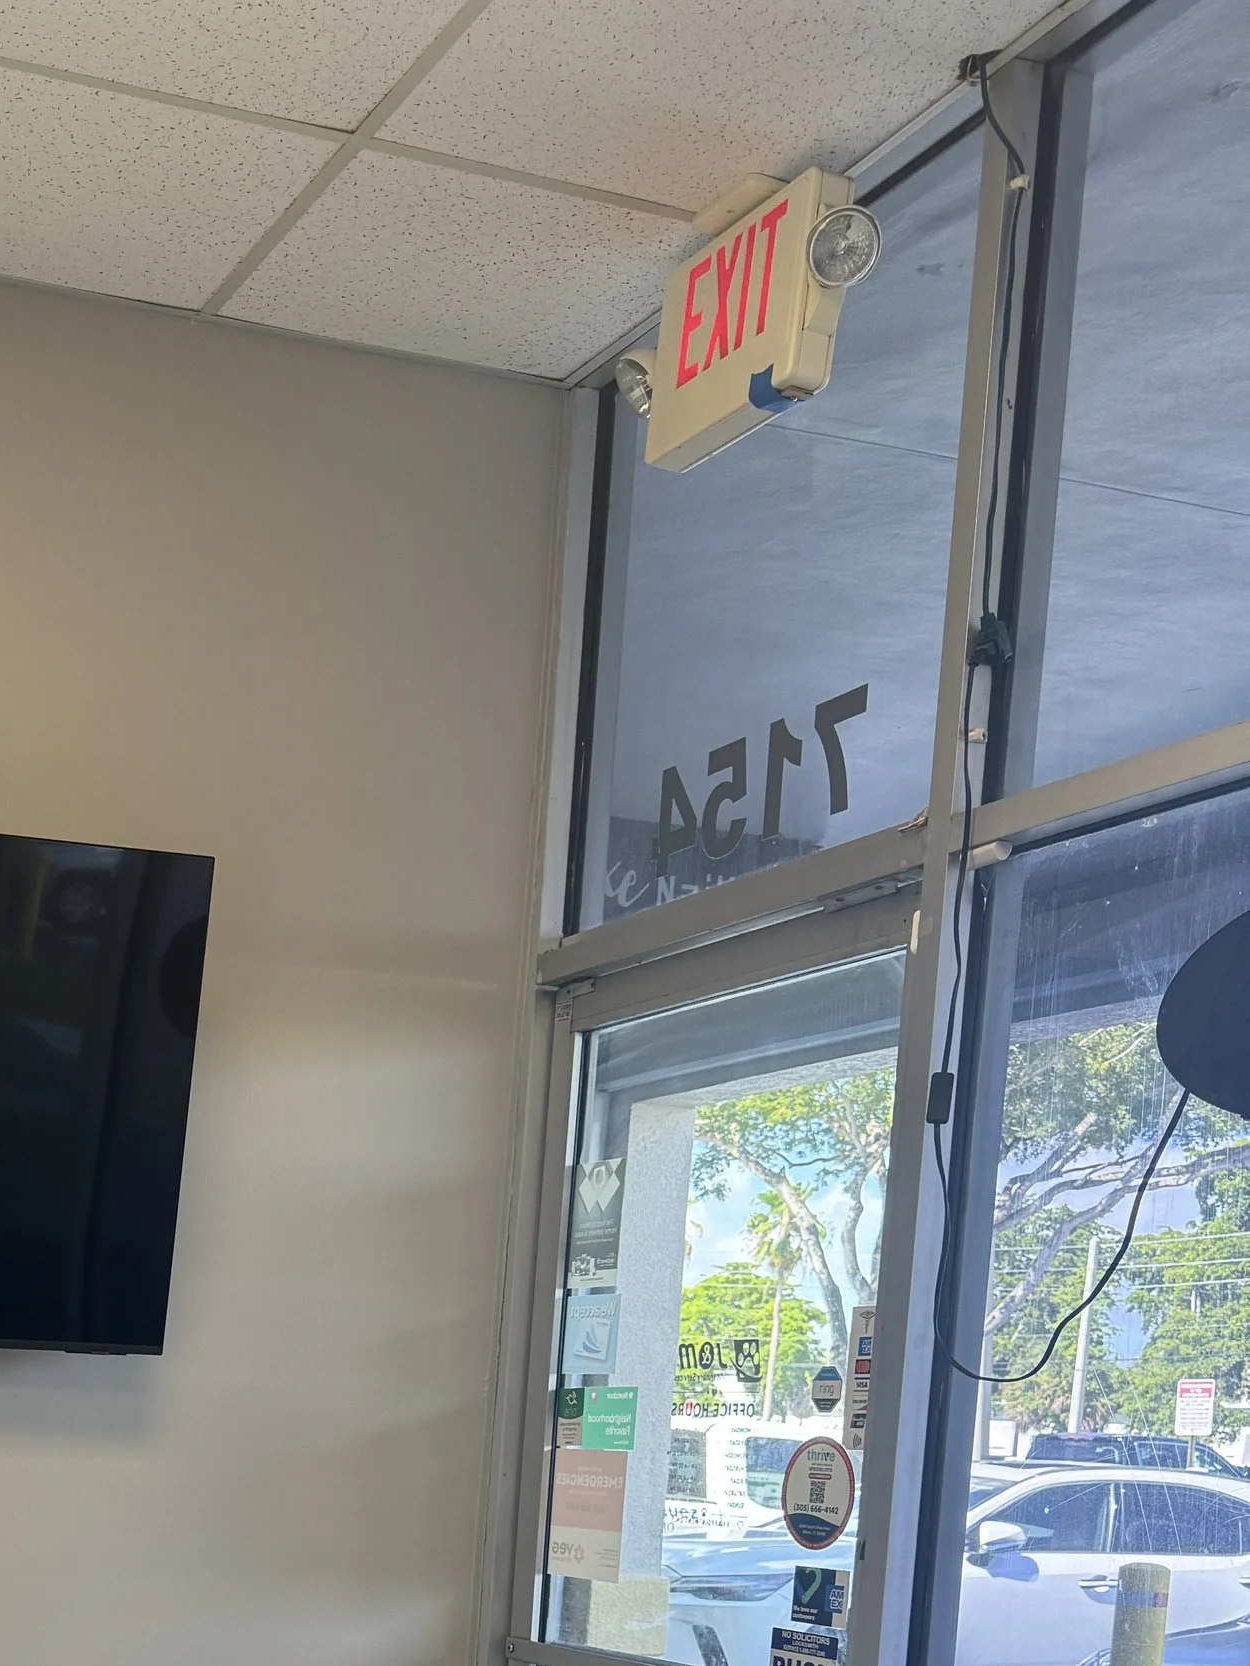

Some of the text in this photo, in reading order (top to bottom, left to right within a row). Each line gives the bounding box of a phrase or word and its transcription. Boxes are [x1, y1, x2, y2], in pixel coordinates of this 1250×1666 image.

[675, 198, 789, 390] EXIT
[819, 1384, 834, 1397] ring
[807, 1448, 835, 1462] thrive
[829, 1589, 844, 1600] AM
[830, 1598, 843, 1609] EX
[781, 1630, 830, 1646] NO SOLICITORS
